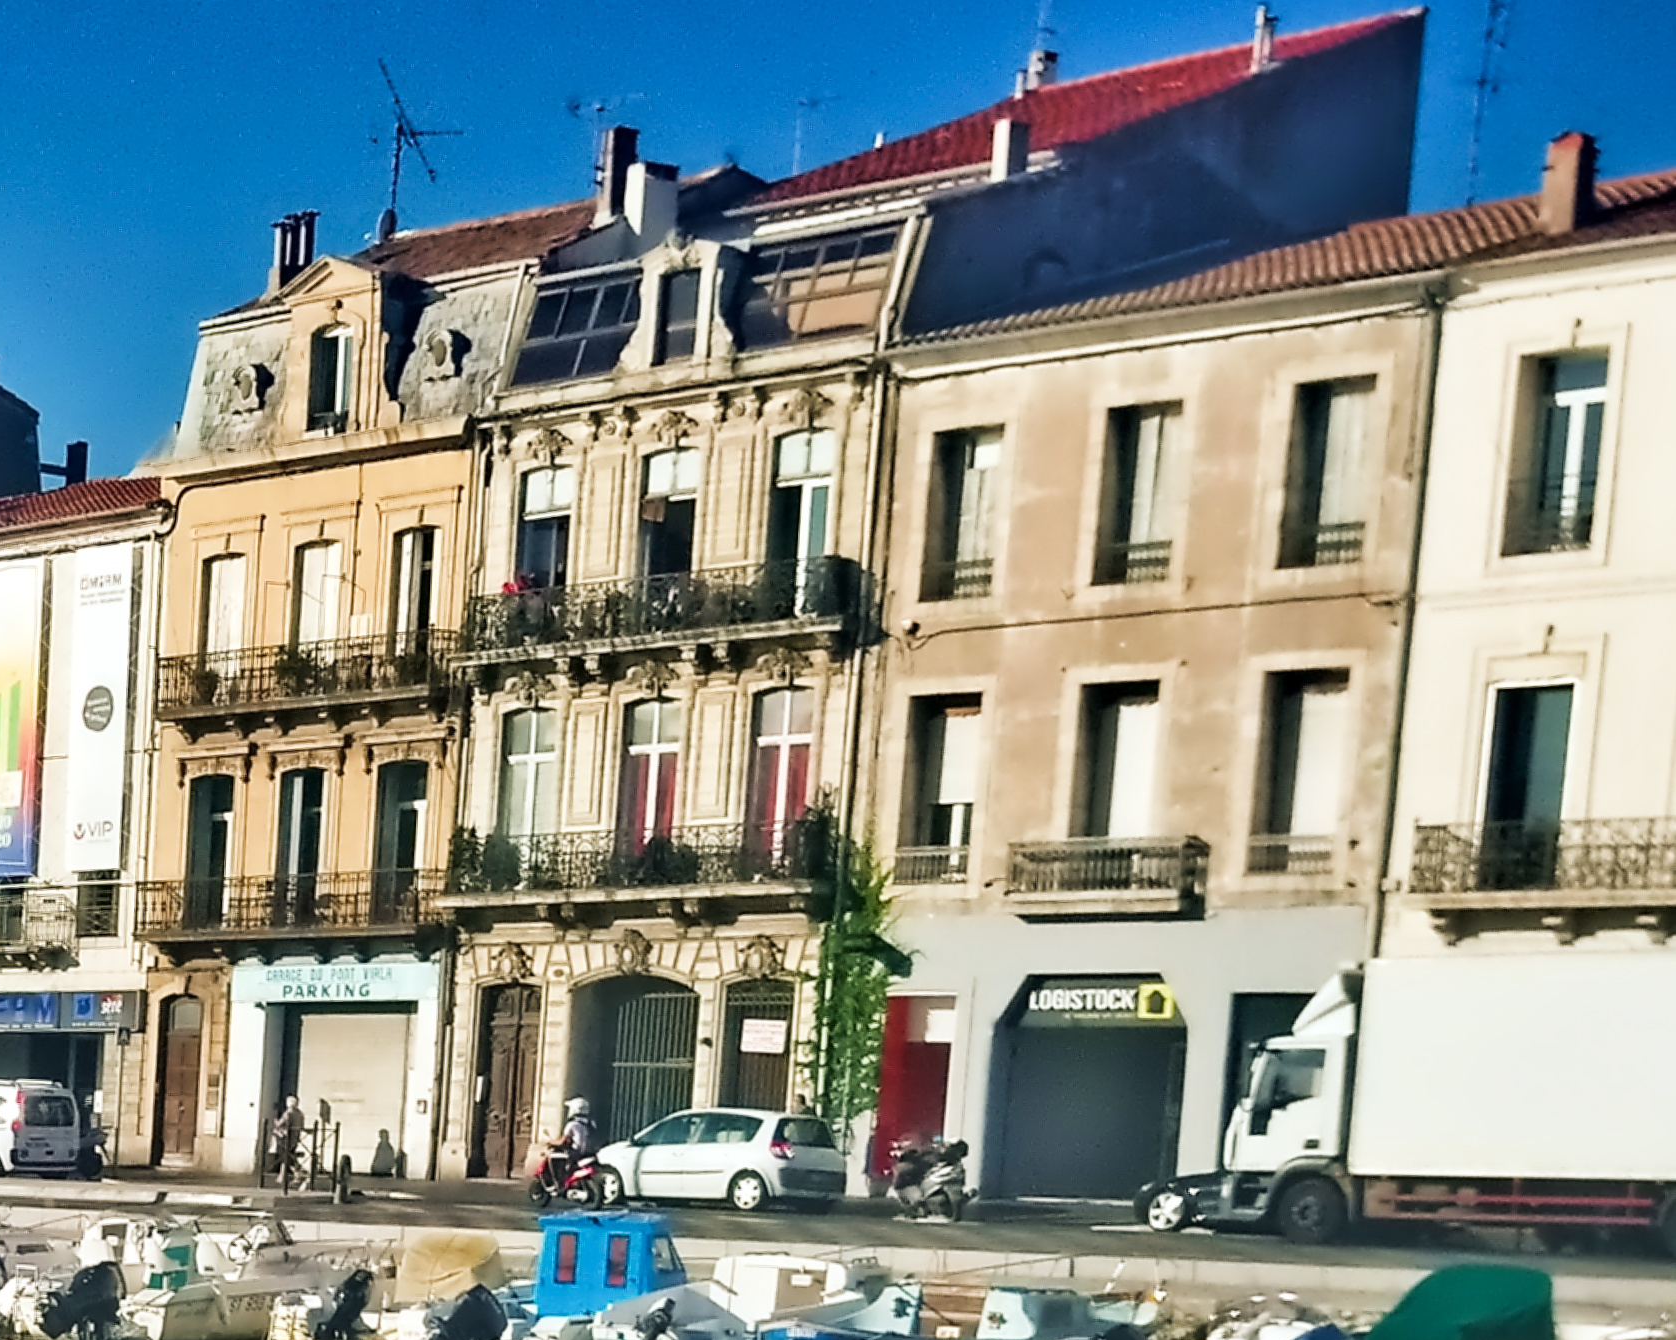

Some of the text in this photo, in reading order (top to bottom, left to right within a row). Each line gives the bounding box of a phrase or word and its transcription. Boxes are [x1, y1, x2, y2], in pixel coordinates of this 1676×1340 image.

[87, 820, 114, 838] VIP
[282, 984, 371, 999] PARKING
[1029, 988, 1136, 1011] LOGISTOCK
